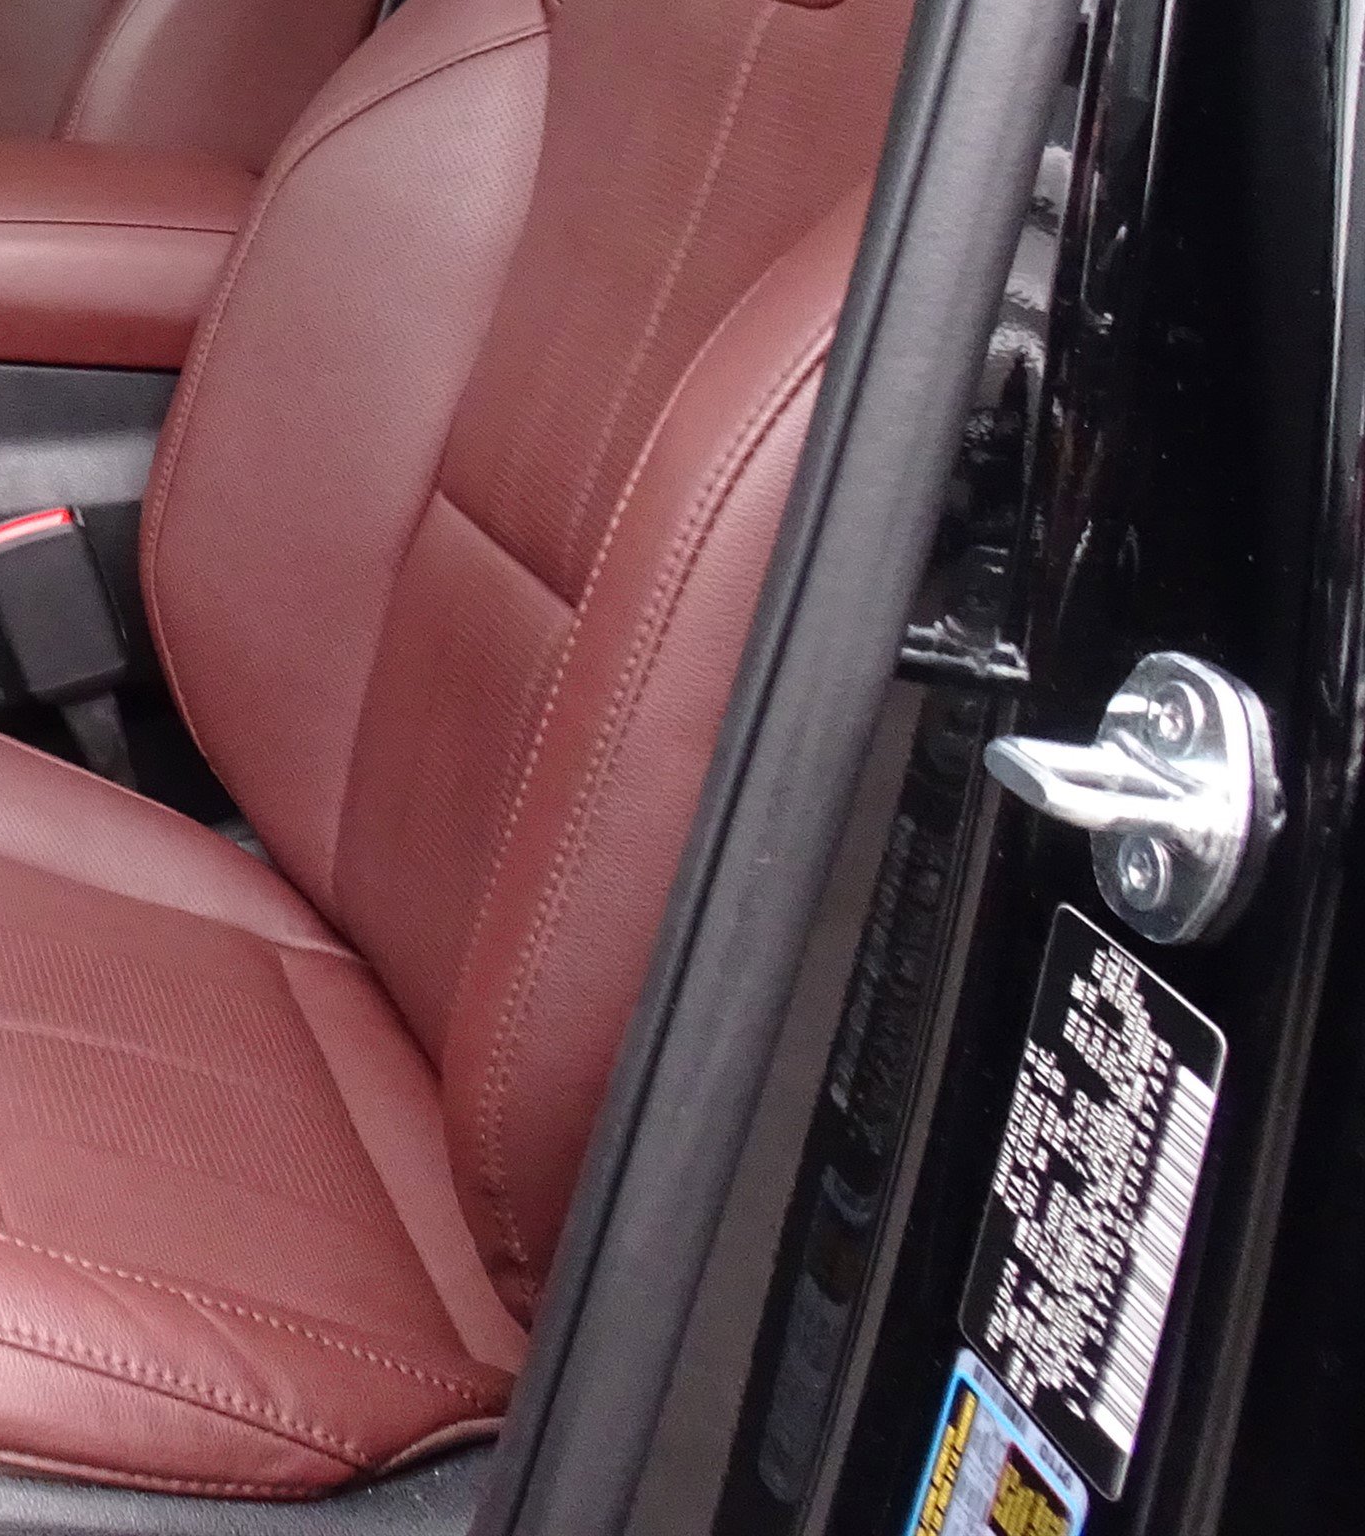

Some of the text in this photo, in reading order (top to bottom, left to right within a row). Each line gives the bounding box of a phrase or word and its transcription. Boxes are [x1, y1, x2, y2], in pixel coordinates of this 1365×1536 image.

[1099, 945, 1123, 1003] SINGLE
[1114, 958, 1138, 1016] SINGLE
[993, 1038, 1039, 1197] MANUFACTURED BY
[985, 1254, 1019, 1354] FEB/19/24
[1019, 1169, 1040, 1218] 5917
[1070, 973, 1087, 1003] WK
[1003, 1170, 1024, 1215] KIA
